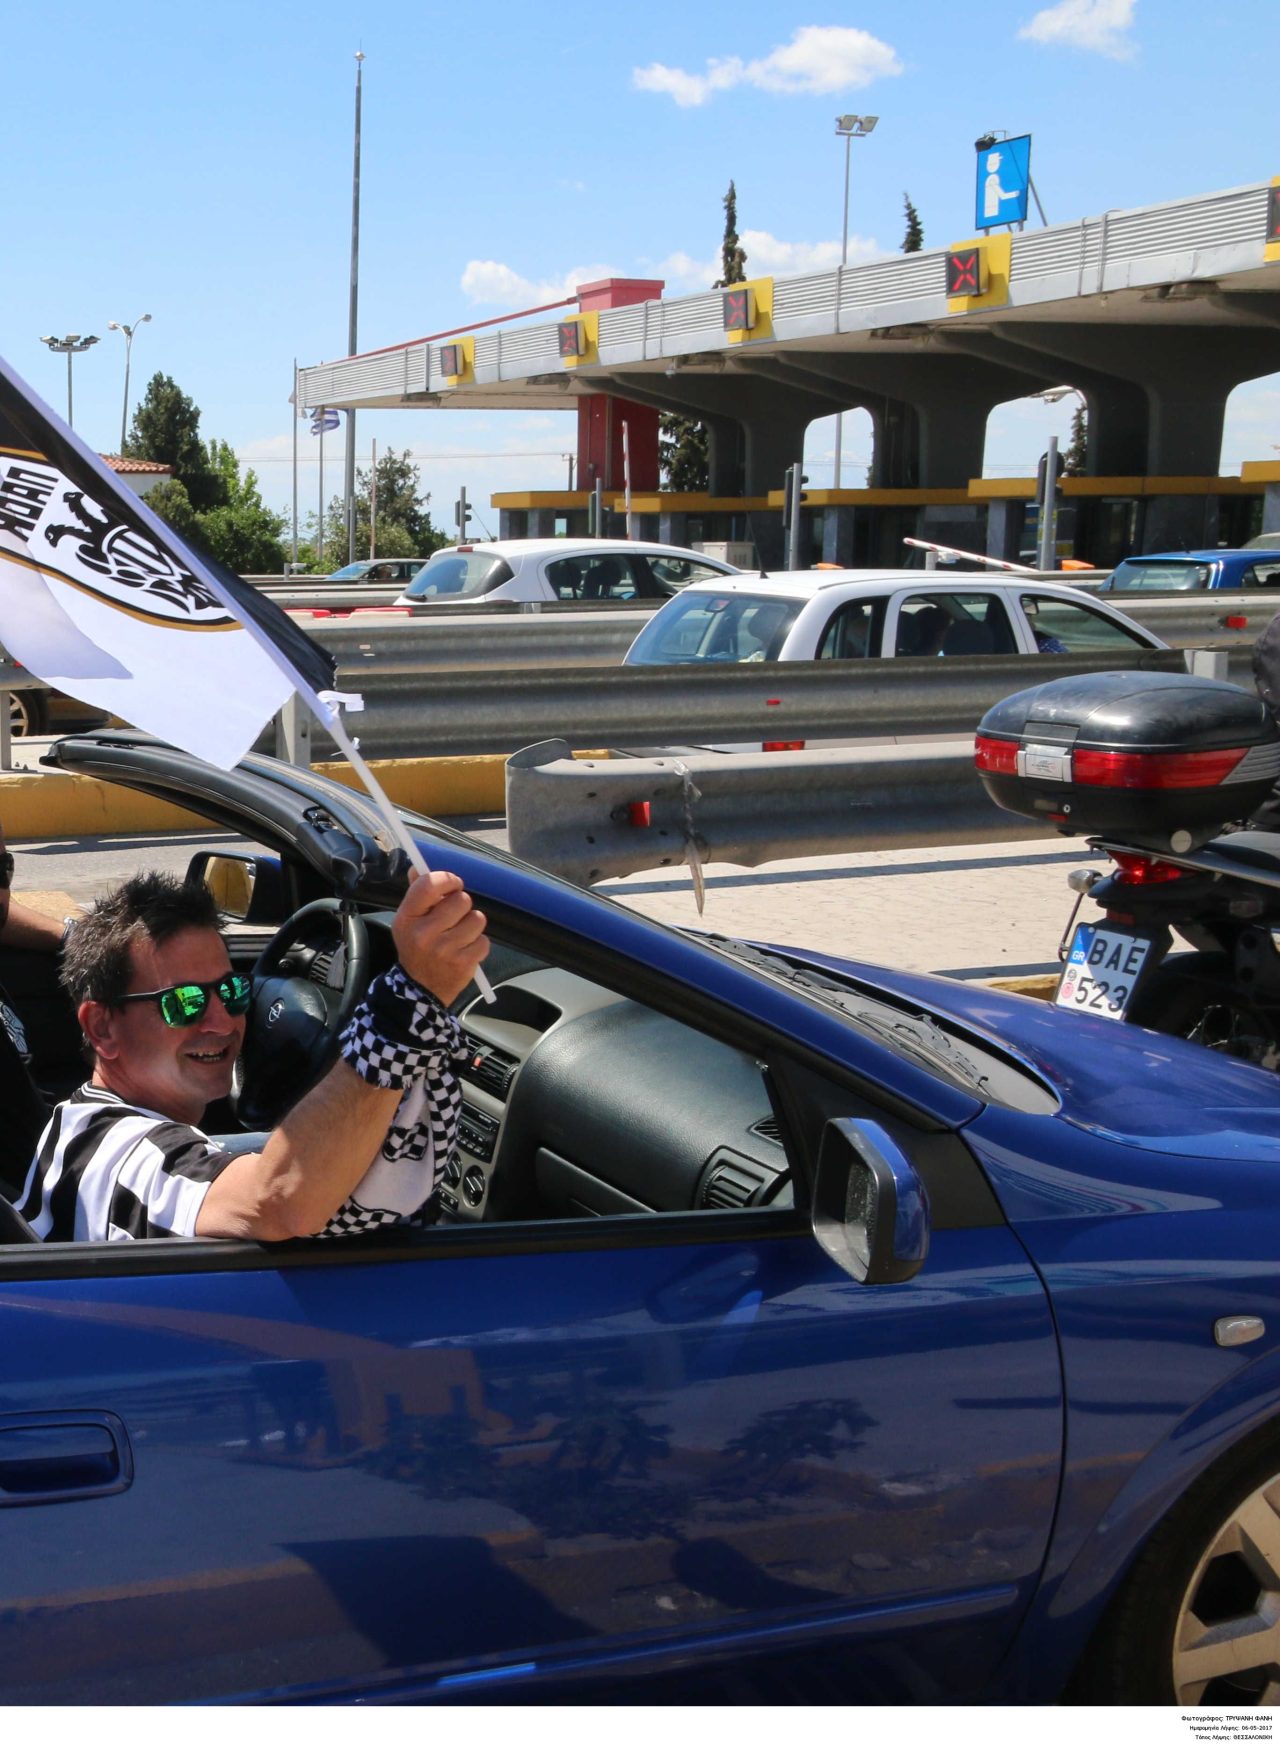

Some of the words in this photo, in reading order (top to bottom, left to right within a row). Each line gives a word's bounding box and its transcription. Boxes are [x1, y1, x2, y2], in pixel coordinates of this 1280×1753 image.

[1072, 951, 1085, 962] GR
[1087, 938, 1146, 976] BAE
[1075, 976, 1129, 1013] 523
